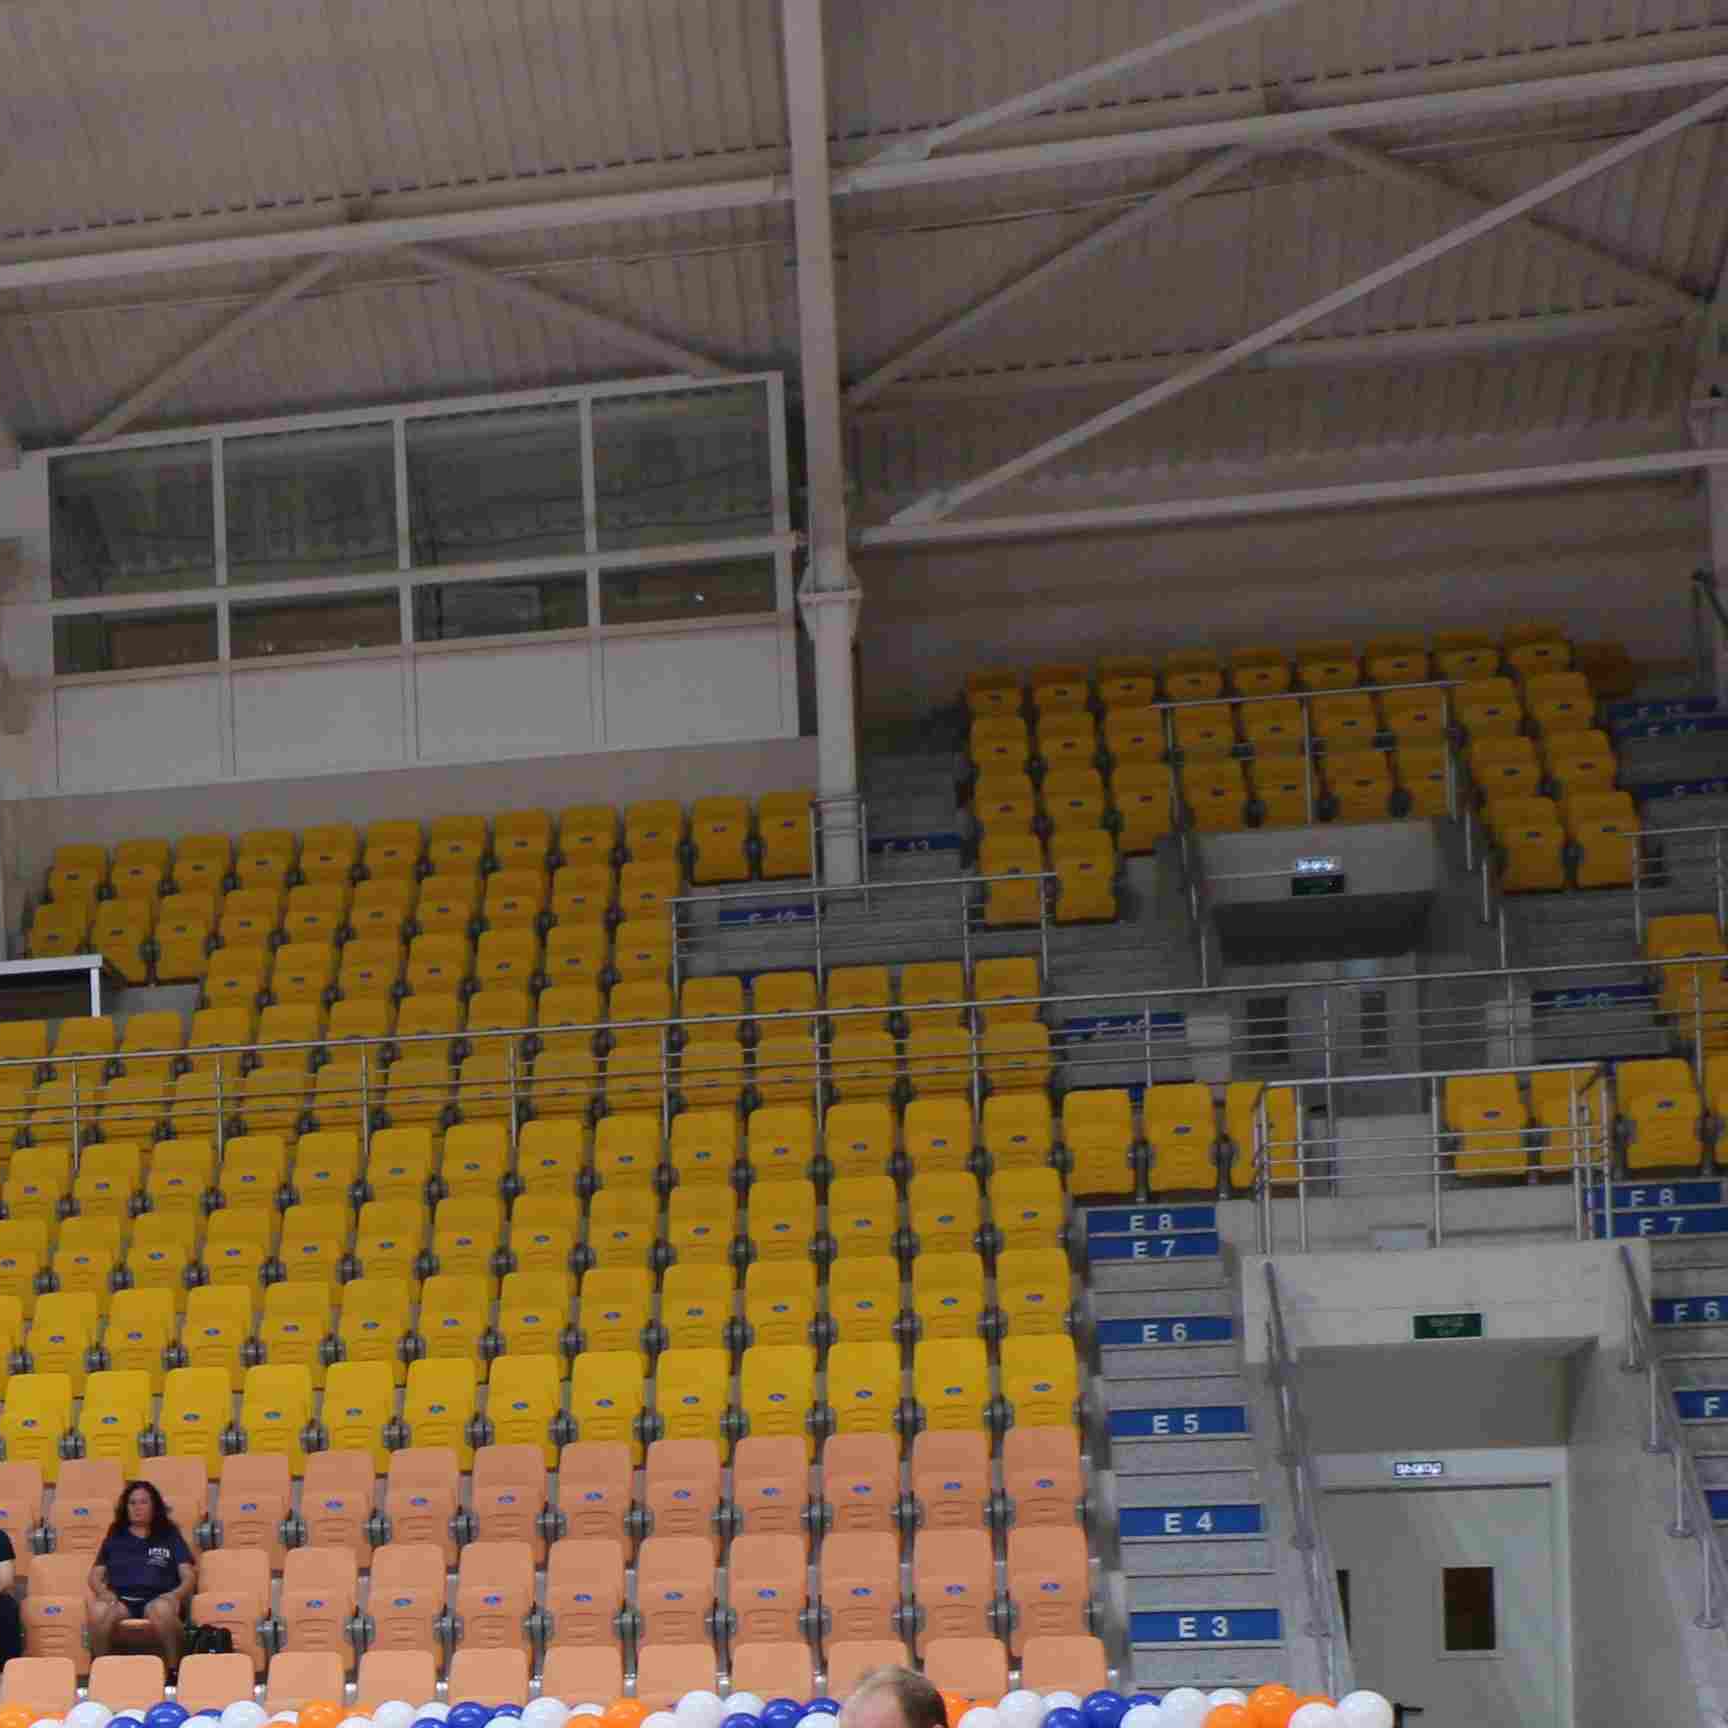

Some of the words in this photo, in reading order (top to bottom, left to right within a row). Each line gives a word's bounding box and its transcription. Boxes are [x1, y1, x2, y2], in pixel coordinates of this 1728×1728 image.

[1659, 1188, 1675, 1206] 8
[1129, 1215, 1144, 1232] E
[1158, 1213, 1173, 1231] 8
[1668, 1216, 1684, 1234] 7
[1132, 1241, 1148, 1259] E
[1161, 1239, 1175, 1257] 7
[1674, 1303, 1689, 1322] F
[1704, 1301, 1720, 1321] 6
[1143, 1324, 1159, 1344] E
[1172, 1323, 1187, 1342] 6
[1704, 1396, 1720, 1417] F
[1153, 1414, 1169, 1434] E
[1183, 1413, 1199, 1433] 5
[1164, 1512, 1182, 1533] E
[1196, 1511, 1213, 1532] 4
[1179, 1616, 1197, 1639] E
[1211, 1615, 1228, 1638] 3
